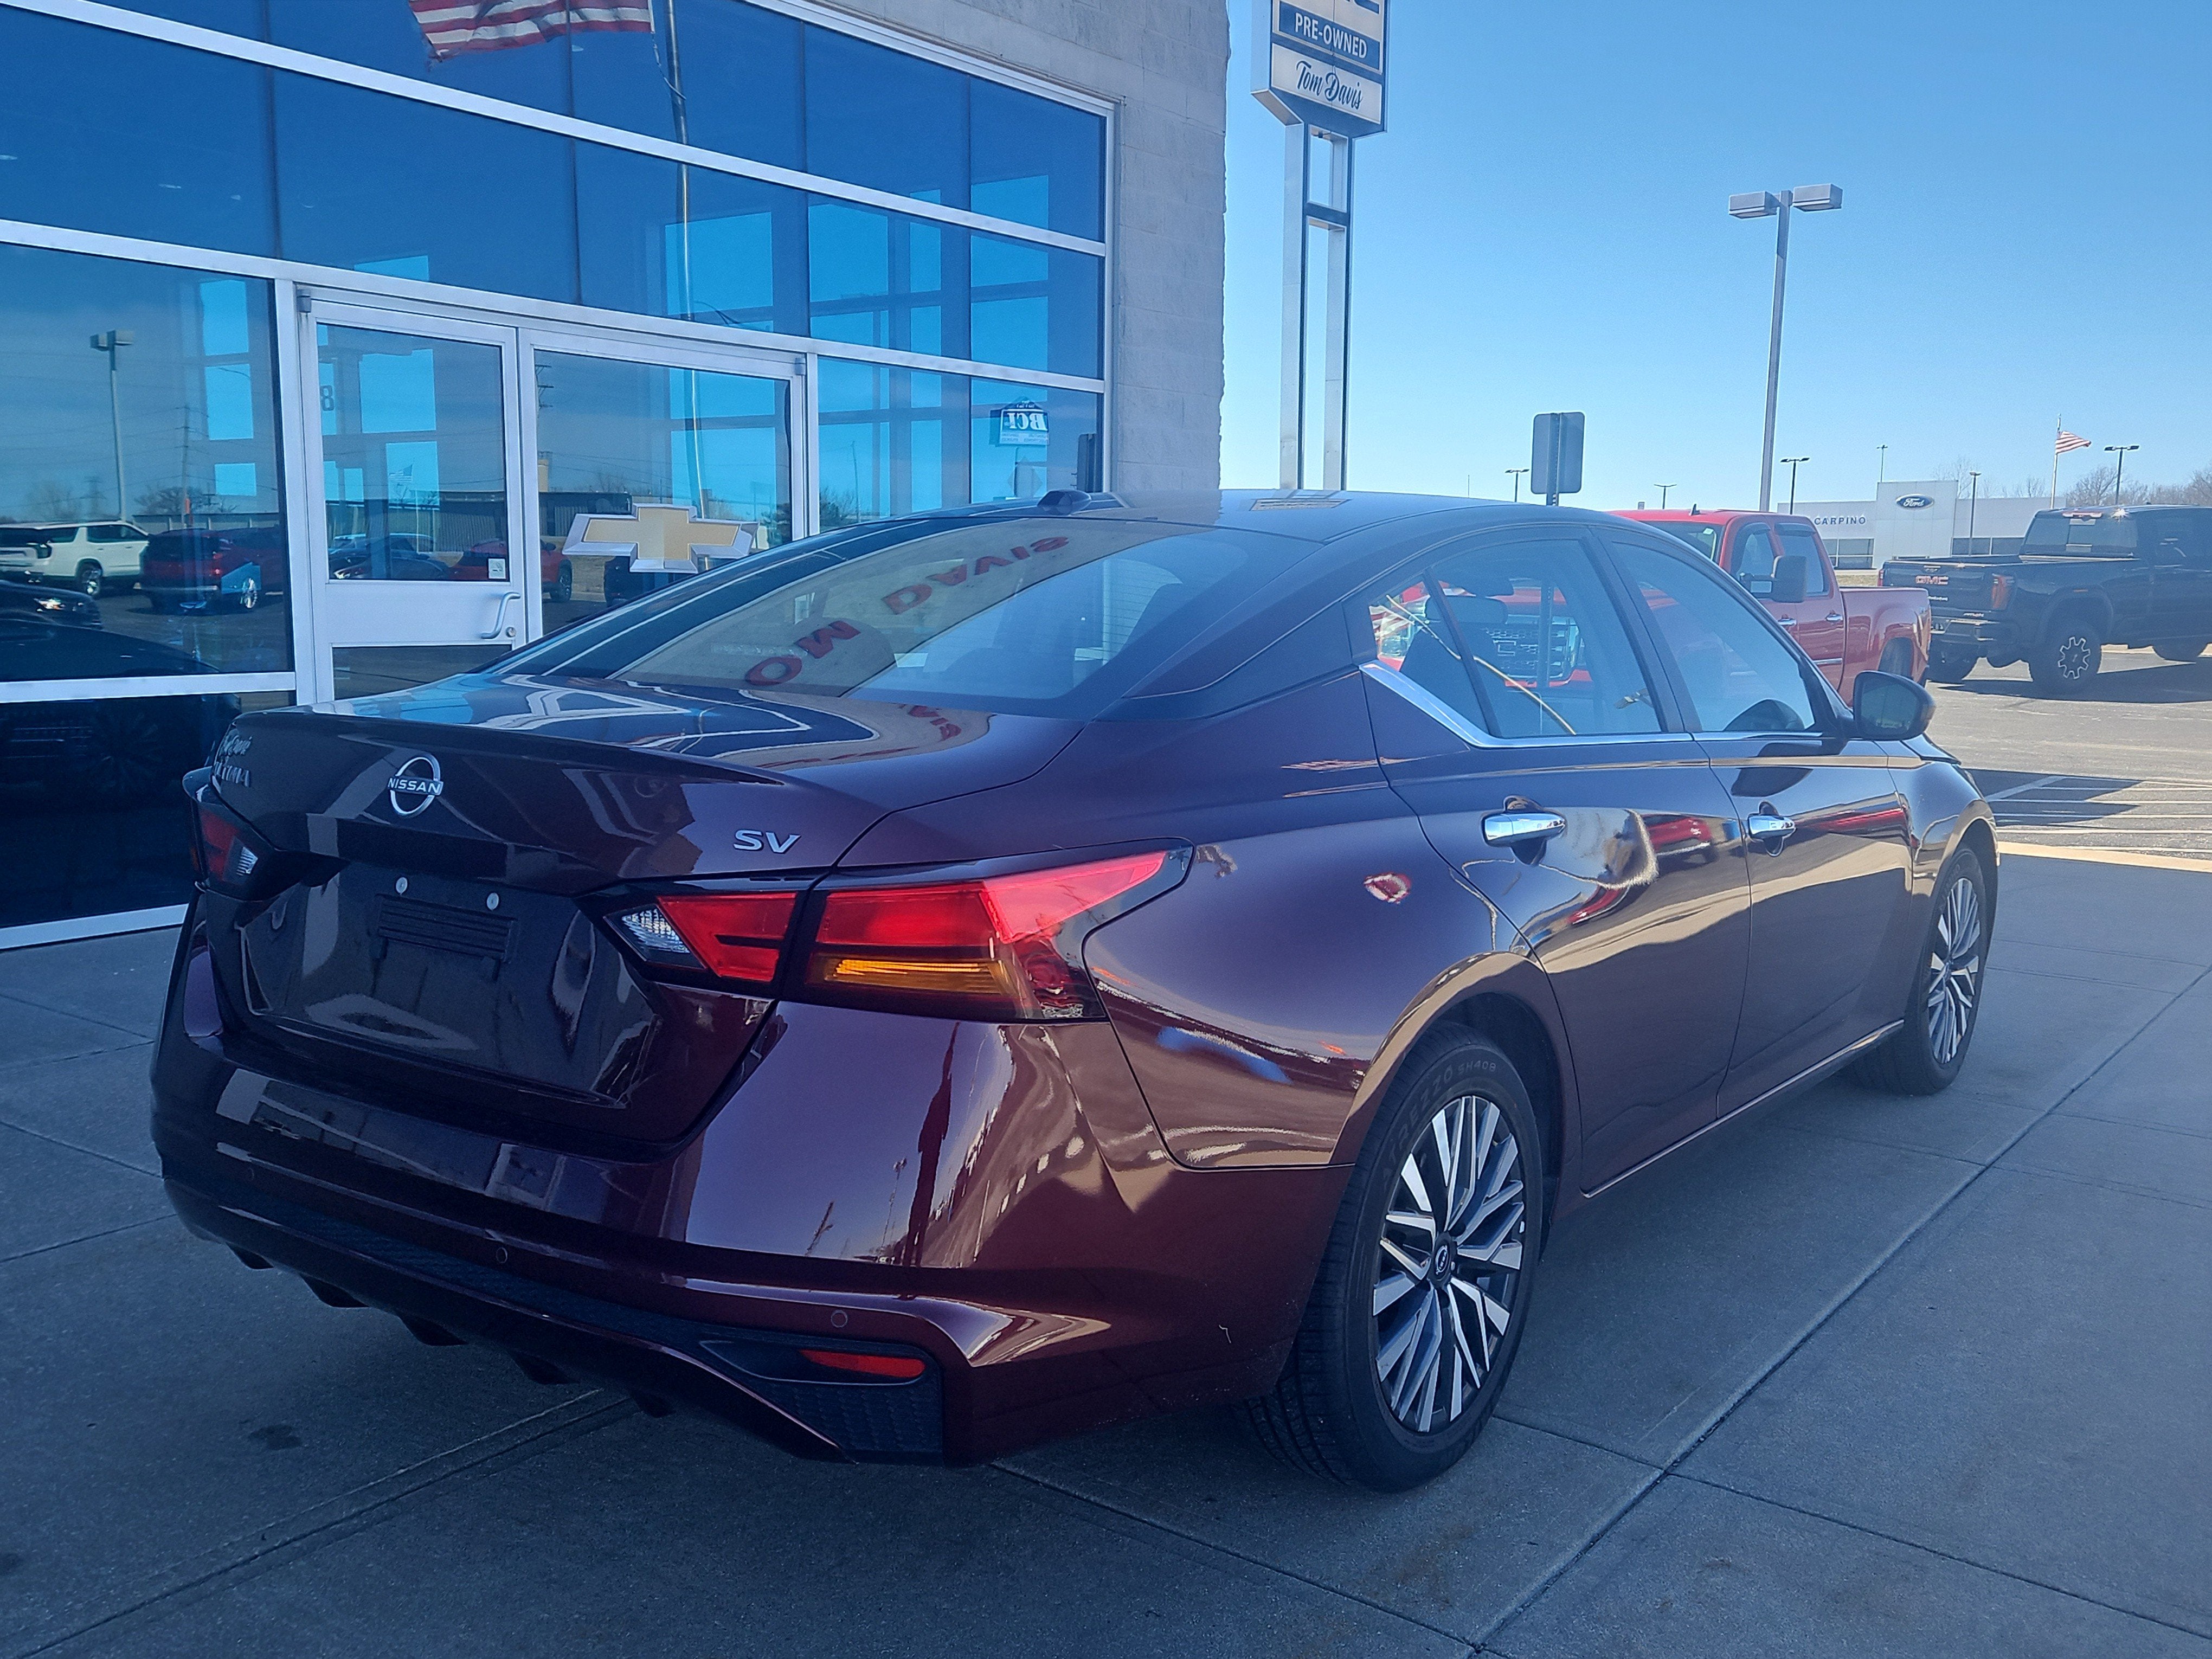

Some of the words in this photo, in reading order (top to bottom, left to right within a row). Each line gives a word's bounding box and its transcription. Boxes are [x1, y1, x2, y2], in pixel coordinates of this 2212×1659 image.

[1295, 12, 1367, 58] PRE-OWNED
[1296, 61, 1323, 96] Tom
[1324, 72, 1364, 110] Davis
[1903, 498, 1925, 507] Ford
[1814, 517, 1866, 525] CARPINO
[1915, 576, 1949, 585] GMC
[388, 778, 441, 793] NISSAN
[733, 829, 801, 853] SV
